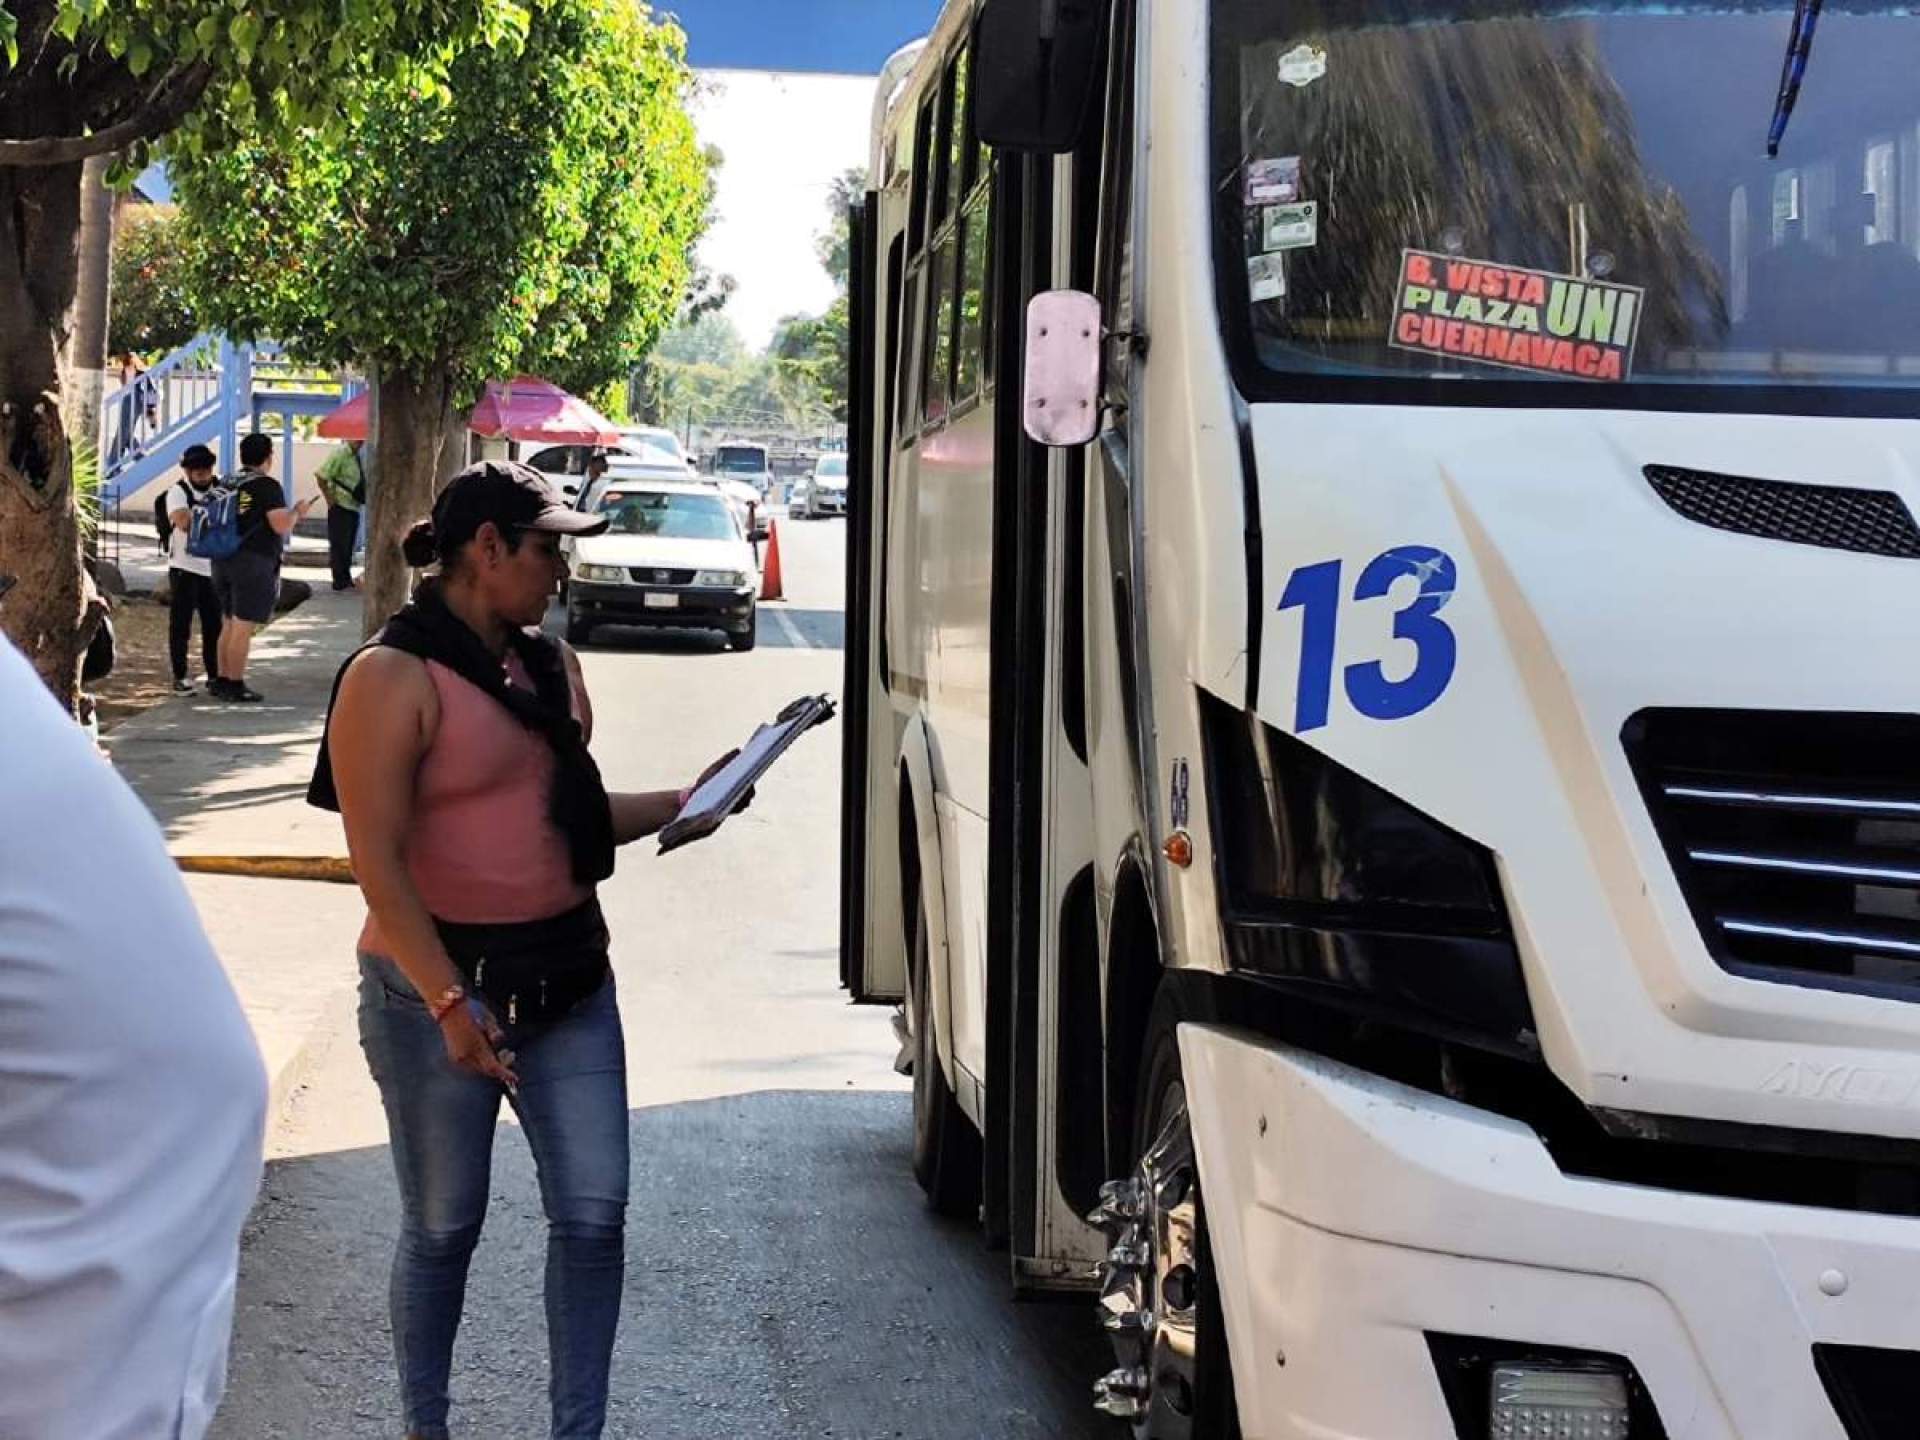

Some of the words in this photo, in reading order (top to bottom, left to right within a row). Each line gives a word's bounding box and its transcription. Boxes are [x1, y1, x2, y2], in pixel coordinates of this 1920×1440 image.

[1402, 285, 1540, 332] PLAZA
[1406, 254, 1437, 287] B.
[1446, 261, 1545, 304] VISTA
[1397, 312, 1622, 380] CUERNAVACA
[1546, 280, 1637, 347] UNI
[1277, 545, 1457, 734] 13
